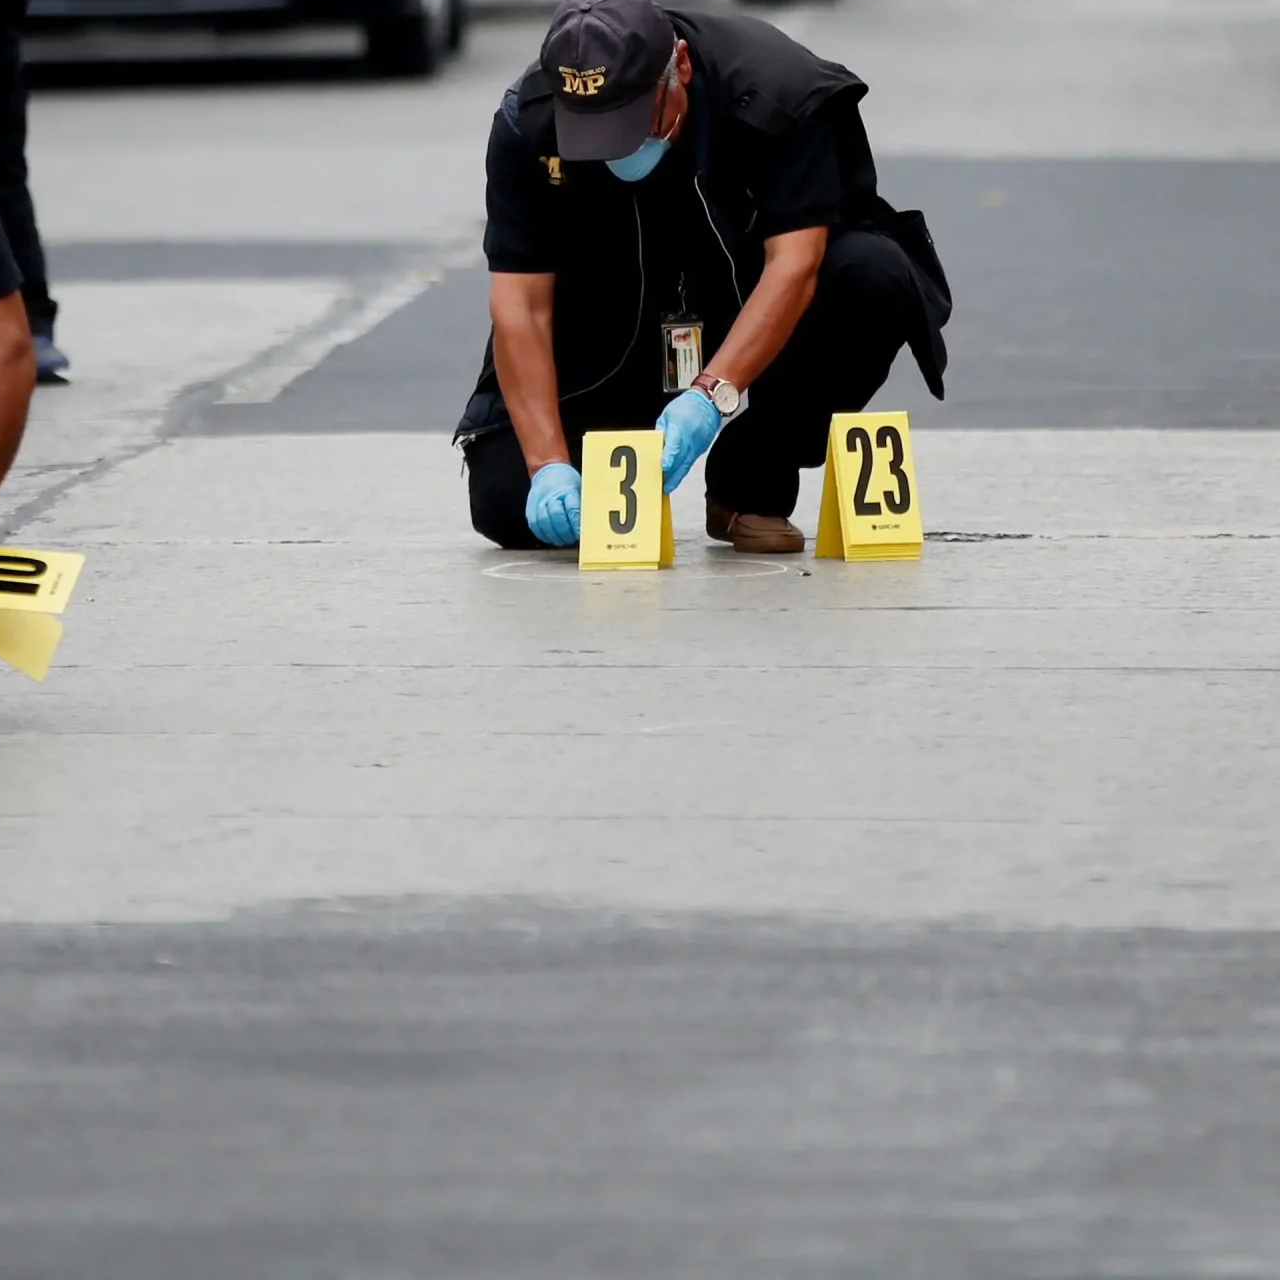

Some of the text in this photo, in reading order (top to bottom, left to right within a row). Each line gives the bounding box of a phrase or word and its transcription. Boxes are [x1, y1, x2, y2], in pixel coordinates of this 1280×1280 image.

[562, 73, 605, 96] MP
[609, 445, 637, 535] 3
[846, 426, 911, 516] 23
